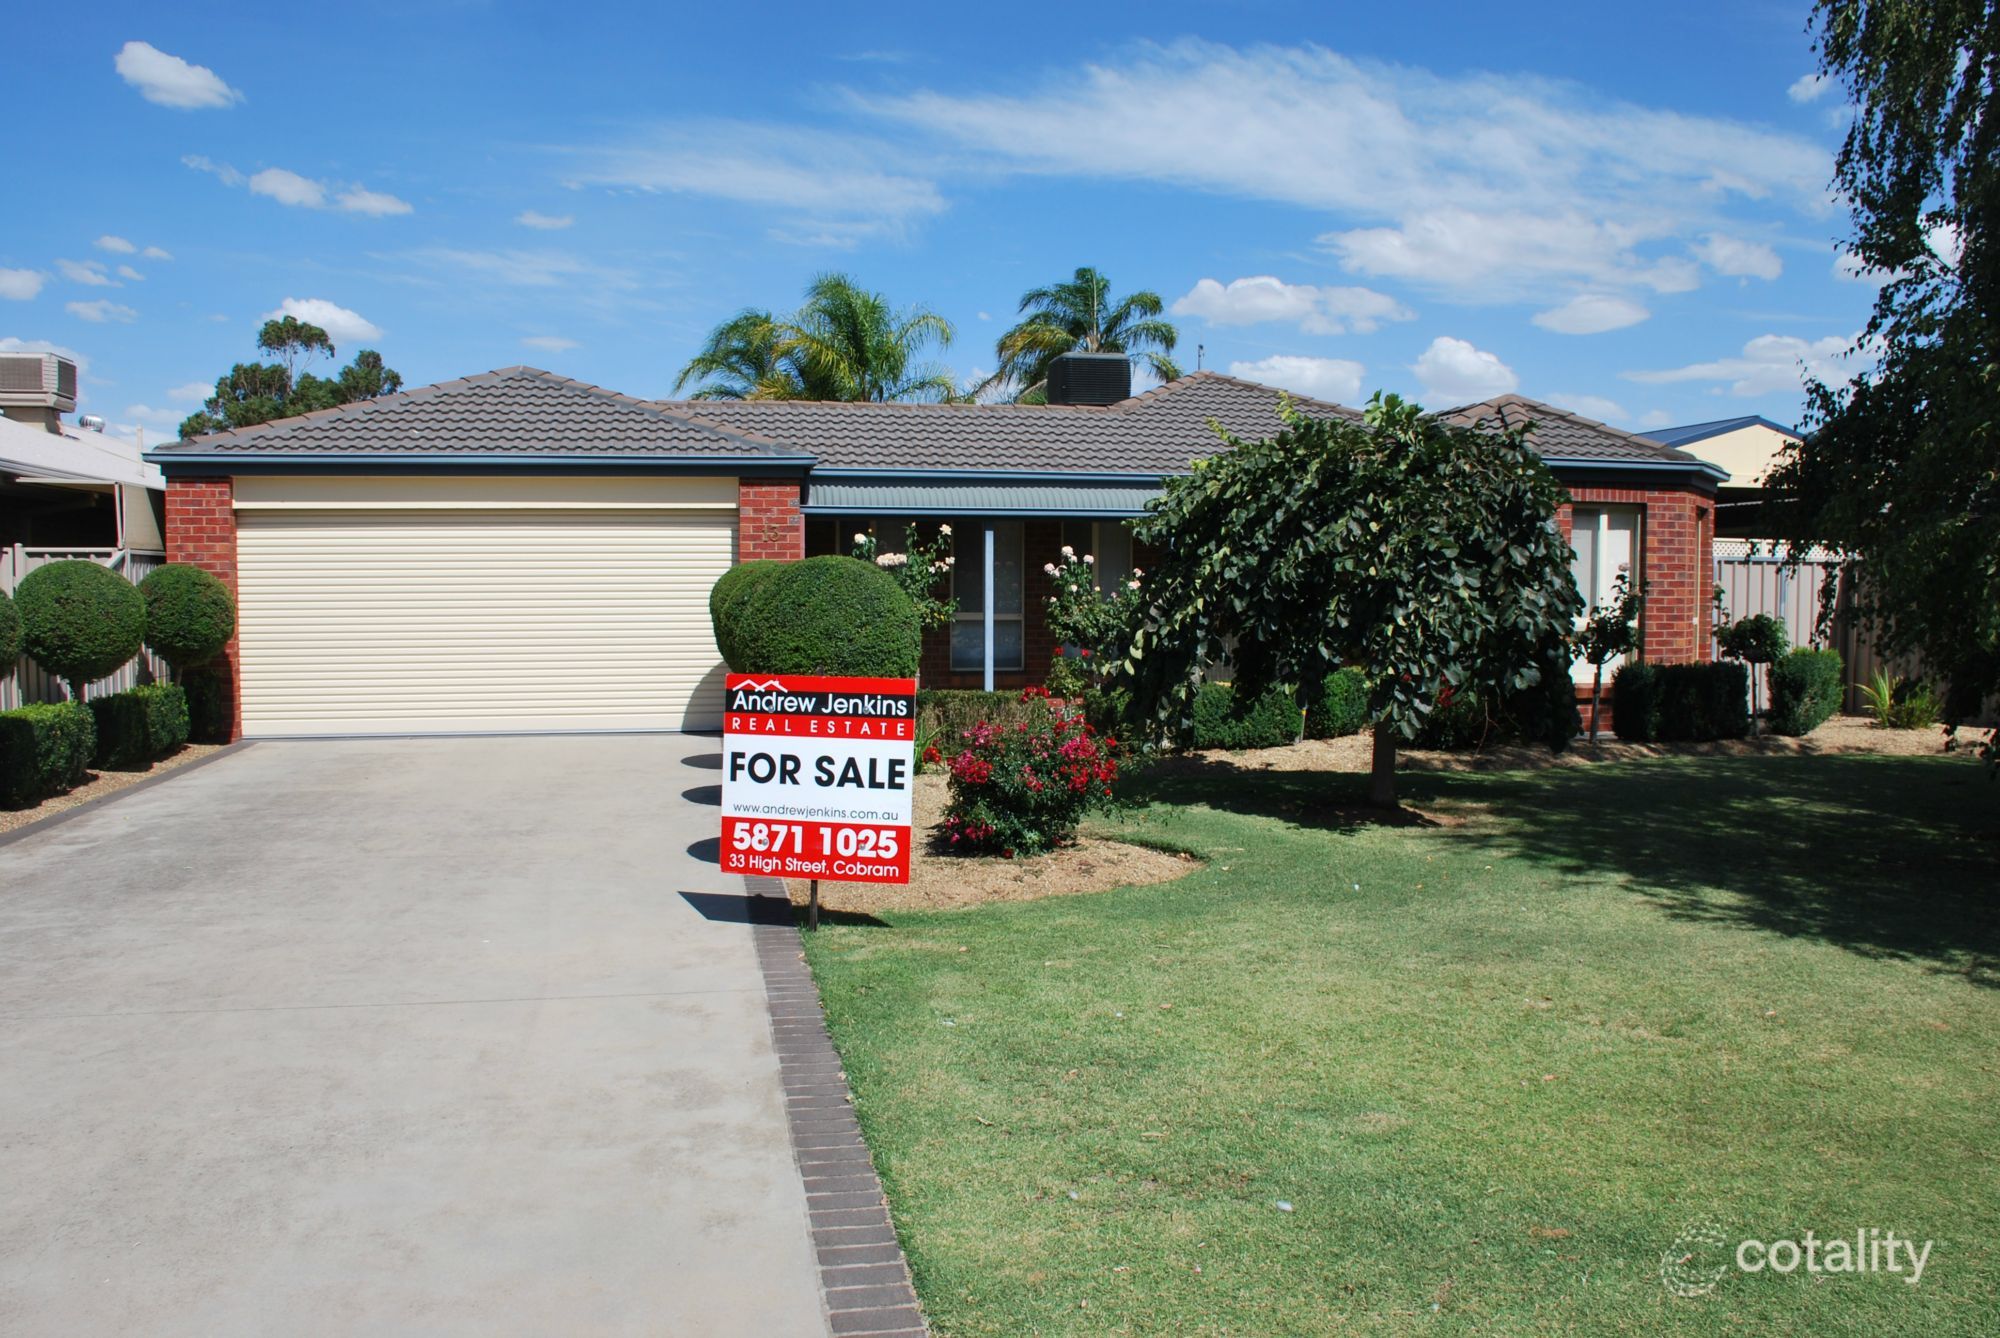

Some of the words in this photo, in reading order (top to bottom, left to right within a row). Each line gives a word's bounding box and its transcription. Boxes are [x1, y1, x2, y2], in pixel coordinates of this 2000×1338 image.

[732, 690, 816, 713] Andrew
[821, 693, 908, 717] Jenkins
[732, 717, 792, 732] REAL
[810, 720, 905, 736] ESTATE
[730, 751, 801, 785] FOR
[814, 755, 906, 790] SALE
[733, 802, 899, 821] www.andrewjenkins.com.au
[732, 822, 803, 854] 5871
[819, 826, 898, 859] 1025
[729, 853, 745, 868] 33
[749, 855, 782, 873] High
[785, 858, 830, 875] Street,
[833, 860, 899, 877] Cobram
